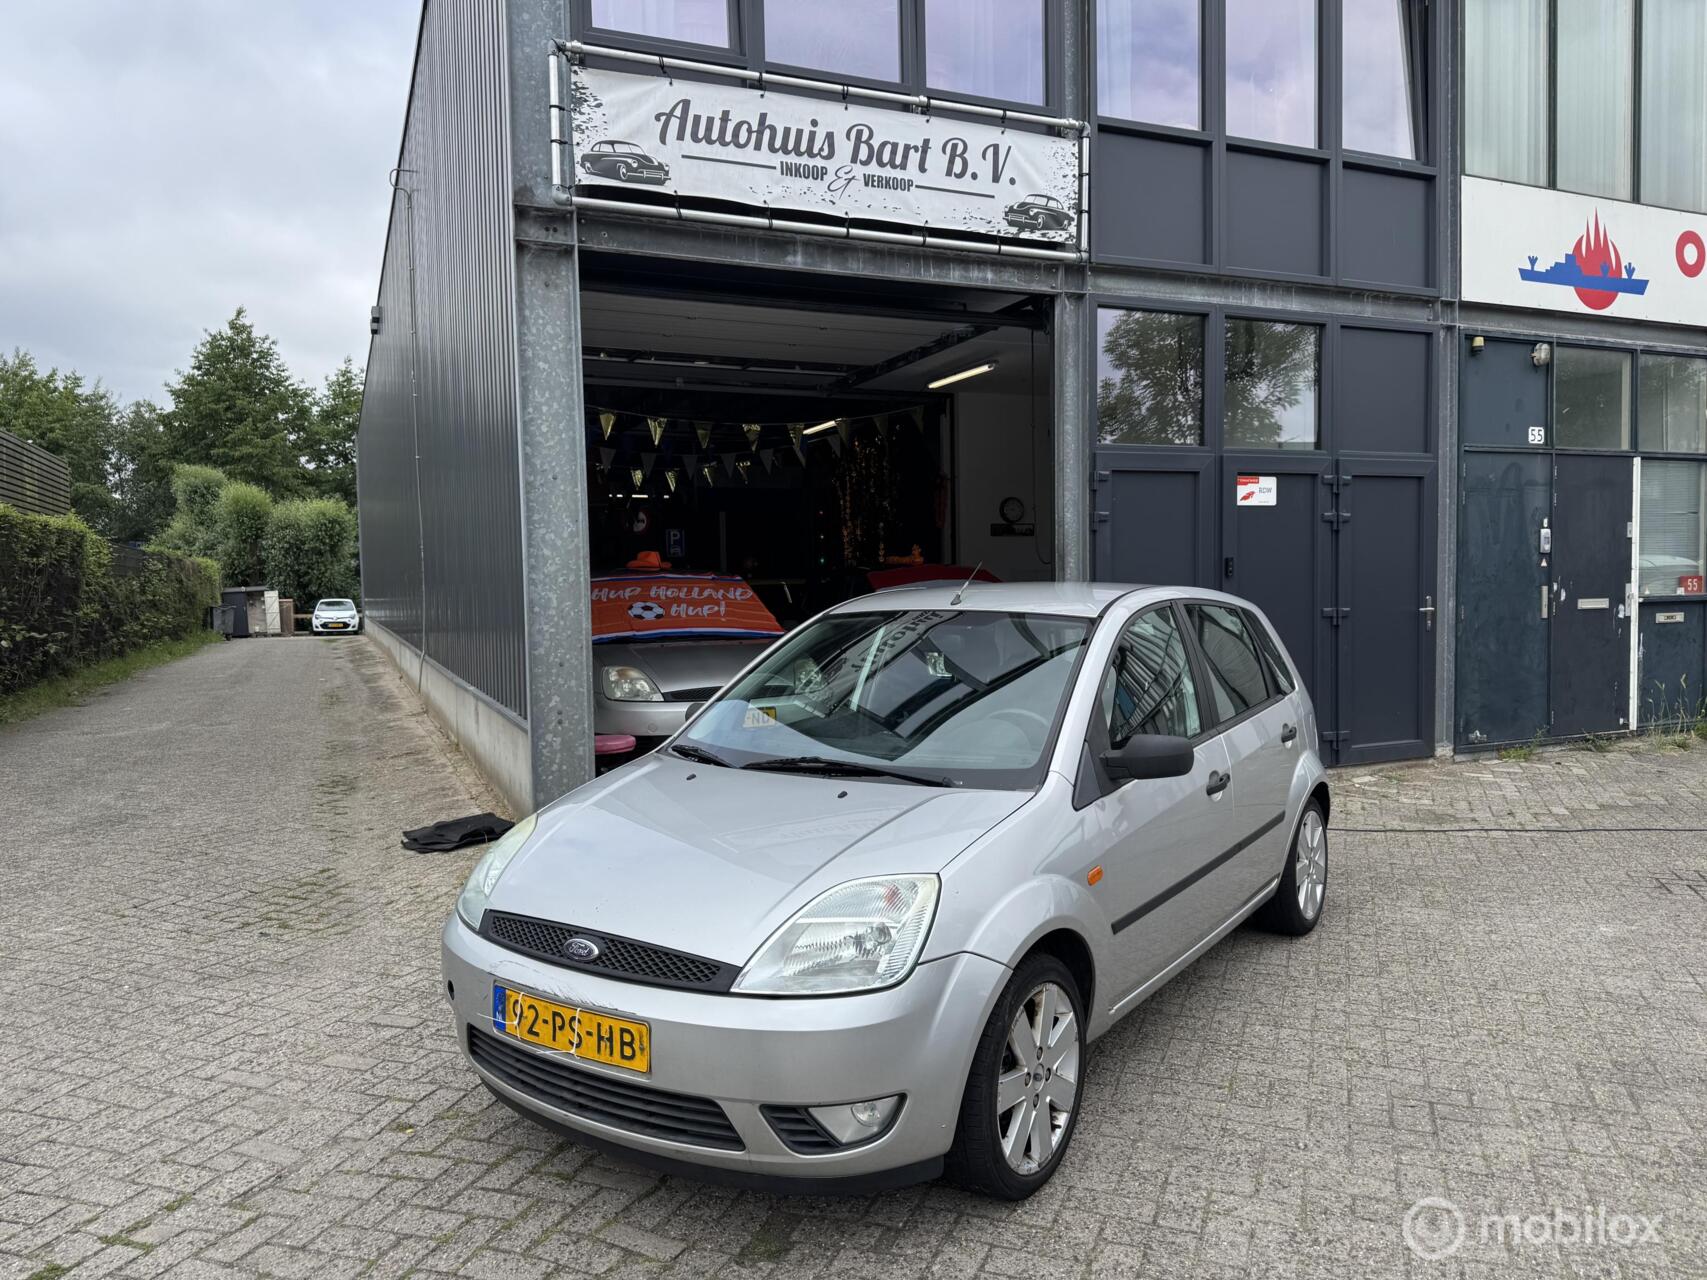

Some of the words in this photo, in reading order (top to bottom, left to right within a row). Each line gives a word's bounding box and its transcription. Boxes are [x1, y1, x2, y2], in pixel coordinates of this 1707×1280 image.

[654, 98, 836, 161] Autohuis
[845, 123, 932, 175] Bart
[941, 137, 1017, 187] B.V.
[780, 161, 828, 182] INKOOP
[863, 174, 914, 192] VERKOOP
[1530, 429, 1544, 442] 55
[1687, 578, 1698, 591] 55
[569, 942, 590, 956] Ford
[512, 999, 635, 1060] 92-PS-HB
